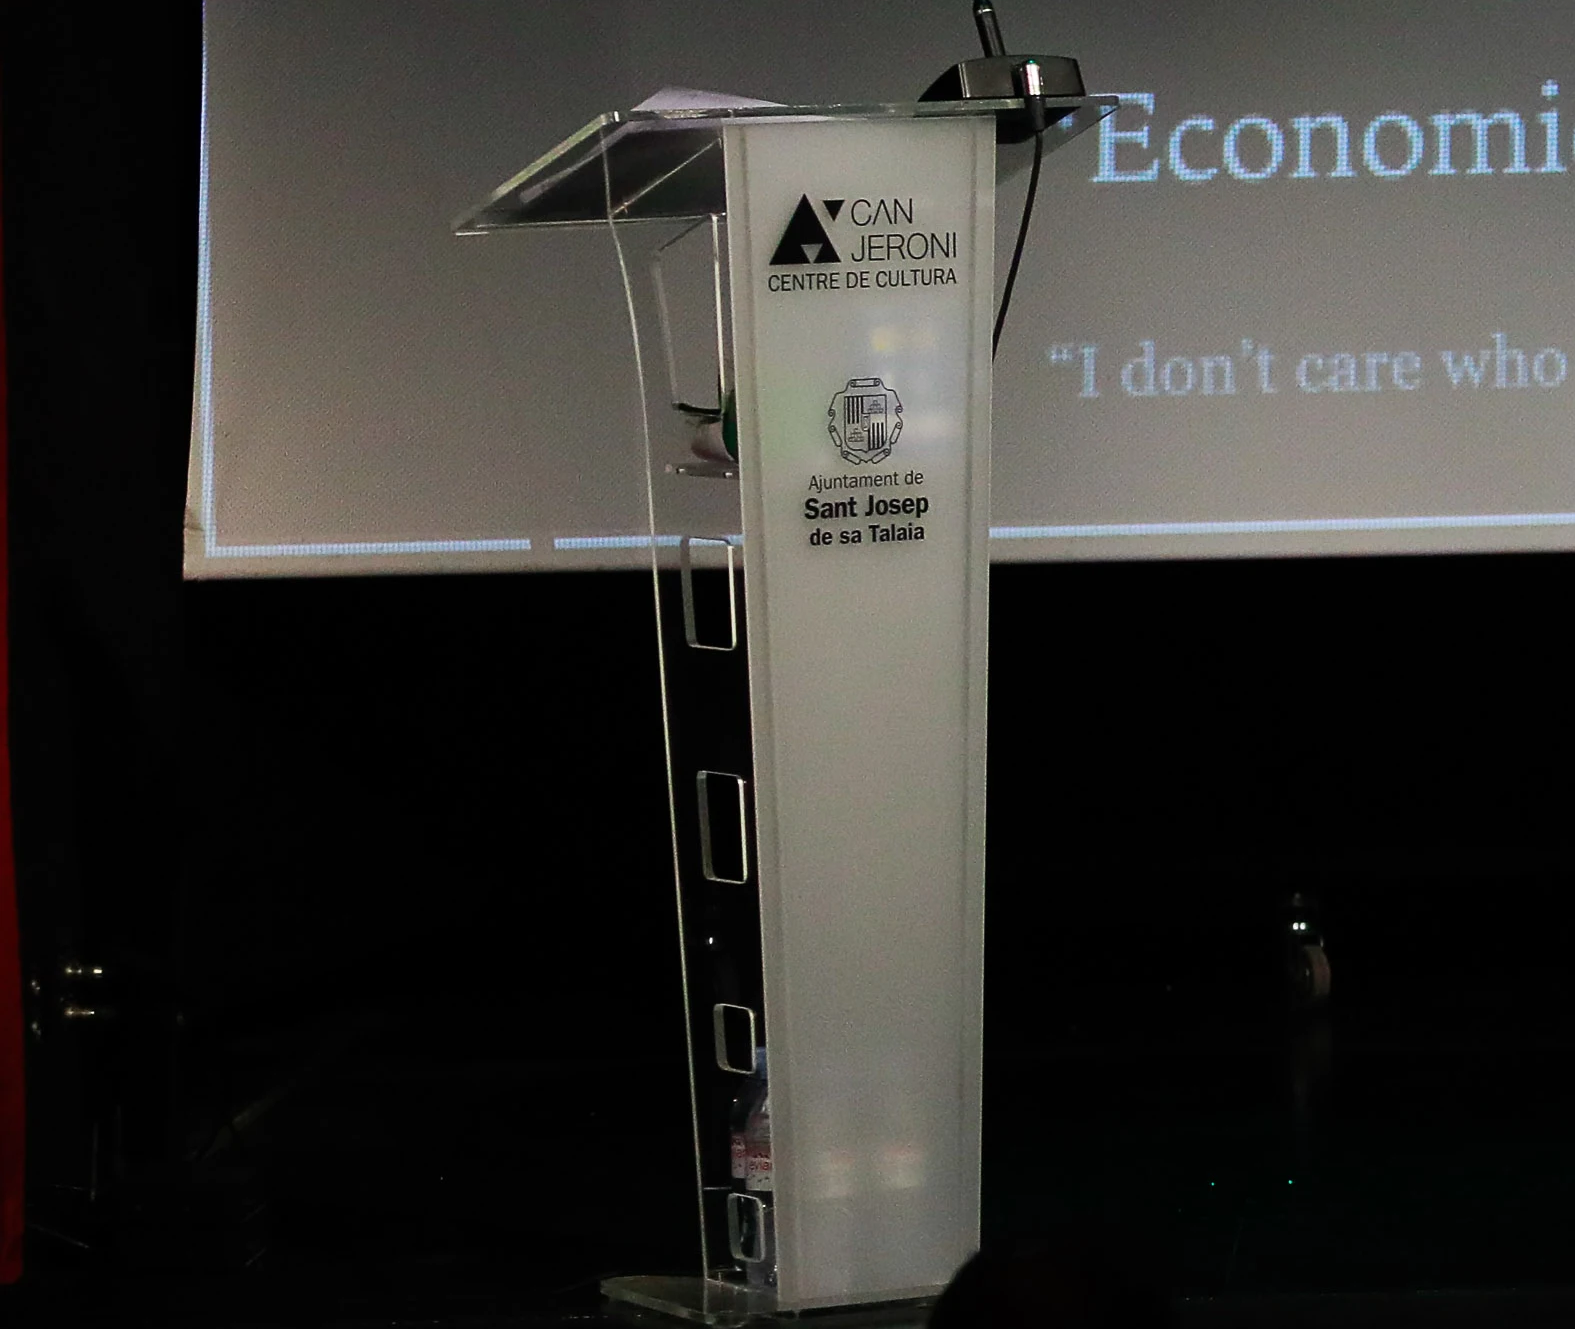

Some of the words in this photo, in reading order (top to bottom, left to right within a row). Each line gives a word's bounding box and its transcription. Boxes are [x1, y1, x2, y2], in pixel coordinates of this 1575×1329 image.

[850, 198, 913, 226] CAN
[851, 232, 957, 263] JERONI
[768, 272, 840, 292] CENTRE
[846, 271, 870, 289] DE
[875, 268, 957, 288] CULTURA
[1296, 350, 1421, 393] care
[1440, 331, 1568, 389] who
[808, 472, 899, 494] Ajuntament
[905, 470, 924, 486] de
[804, 497, 858, 520] Sant
[864, 494, 929, 520] Josep
[809, 528, 833, 546] de
[839, 530, 862, 545] sa
[868, 523, 925, 544] Talaia
